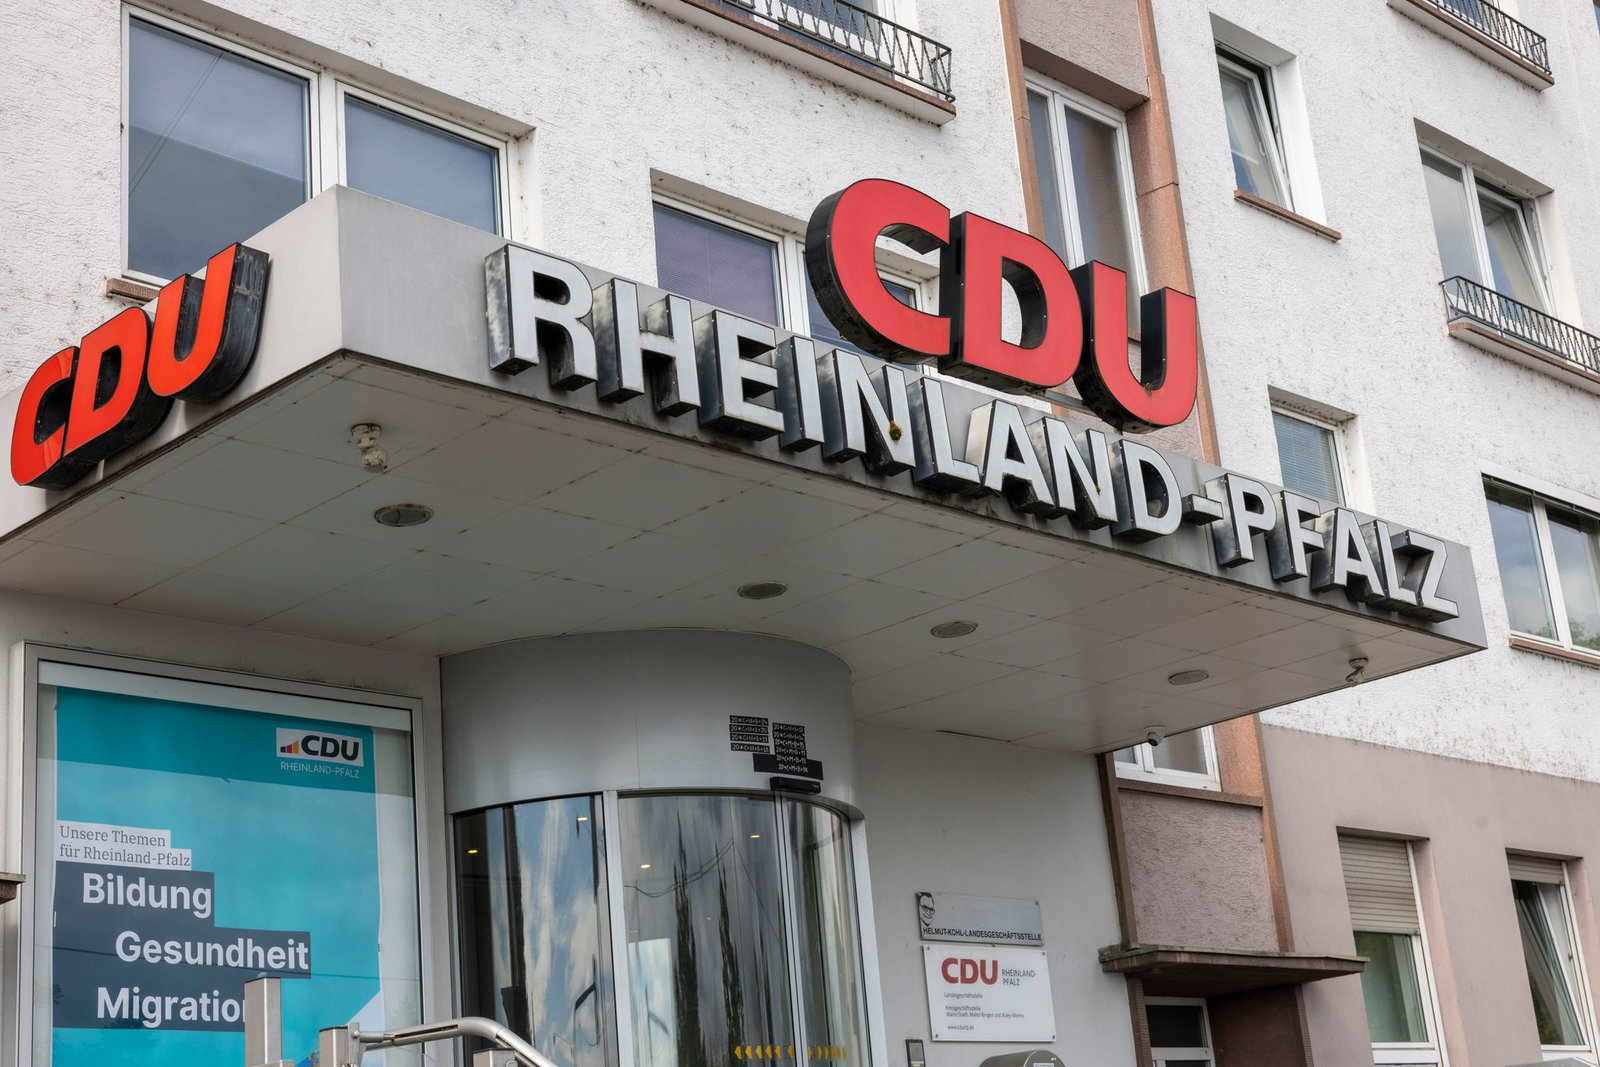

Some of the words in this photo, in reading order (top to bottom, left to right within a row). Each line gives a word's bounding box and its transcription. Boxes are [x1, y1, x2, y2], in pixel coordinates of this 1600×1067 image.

[807, 179, 1198, 432] CDU
[11, 242, 271, 490] CDU
[484, 244, 1458, 622] RHEINLAND-PFALZ
[301, 734, 360, 762] CDU
[280, 762, 361, 779] RHEINLAND-PFALZ
[59, 825, 109, 843] Unsere
[111, 830, 167, 848] Themen
[59, 845, 81, 860] für
[83, 846, 191, 868] Rheinland-Pfalz
[83, 873, 213, 919] Bildung
[923, 927, 1042, 941] HELMUT-KOHL-LANDESGESCHÄFTSSTELLE
[115, 931, 310, 971] Gesundheit
[941, 957, 998, 985] CDU
[1002, 968, 1036, 978] RHEINLAND-
[1003, 978, 1020, 986] PFALZ
[97, 987, 245, 1029] Migratio
